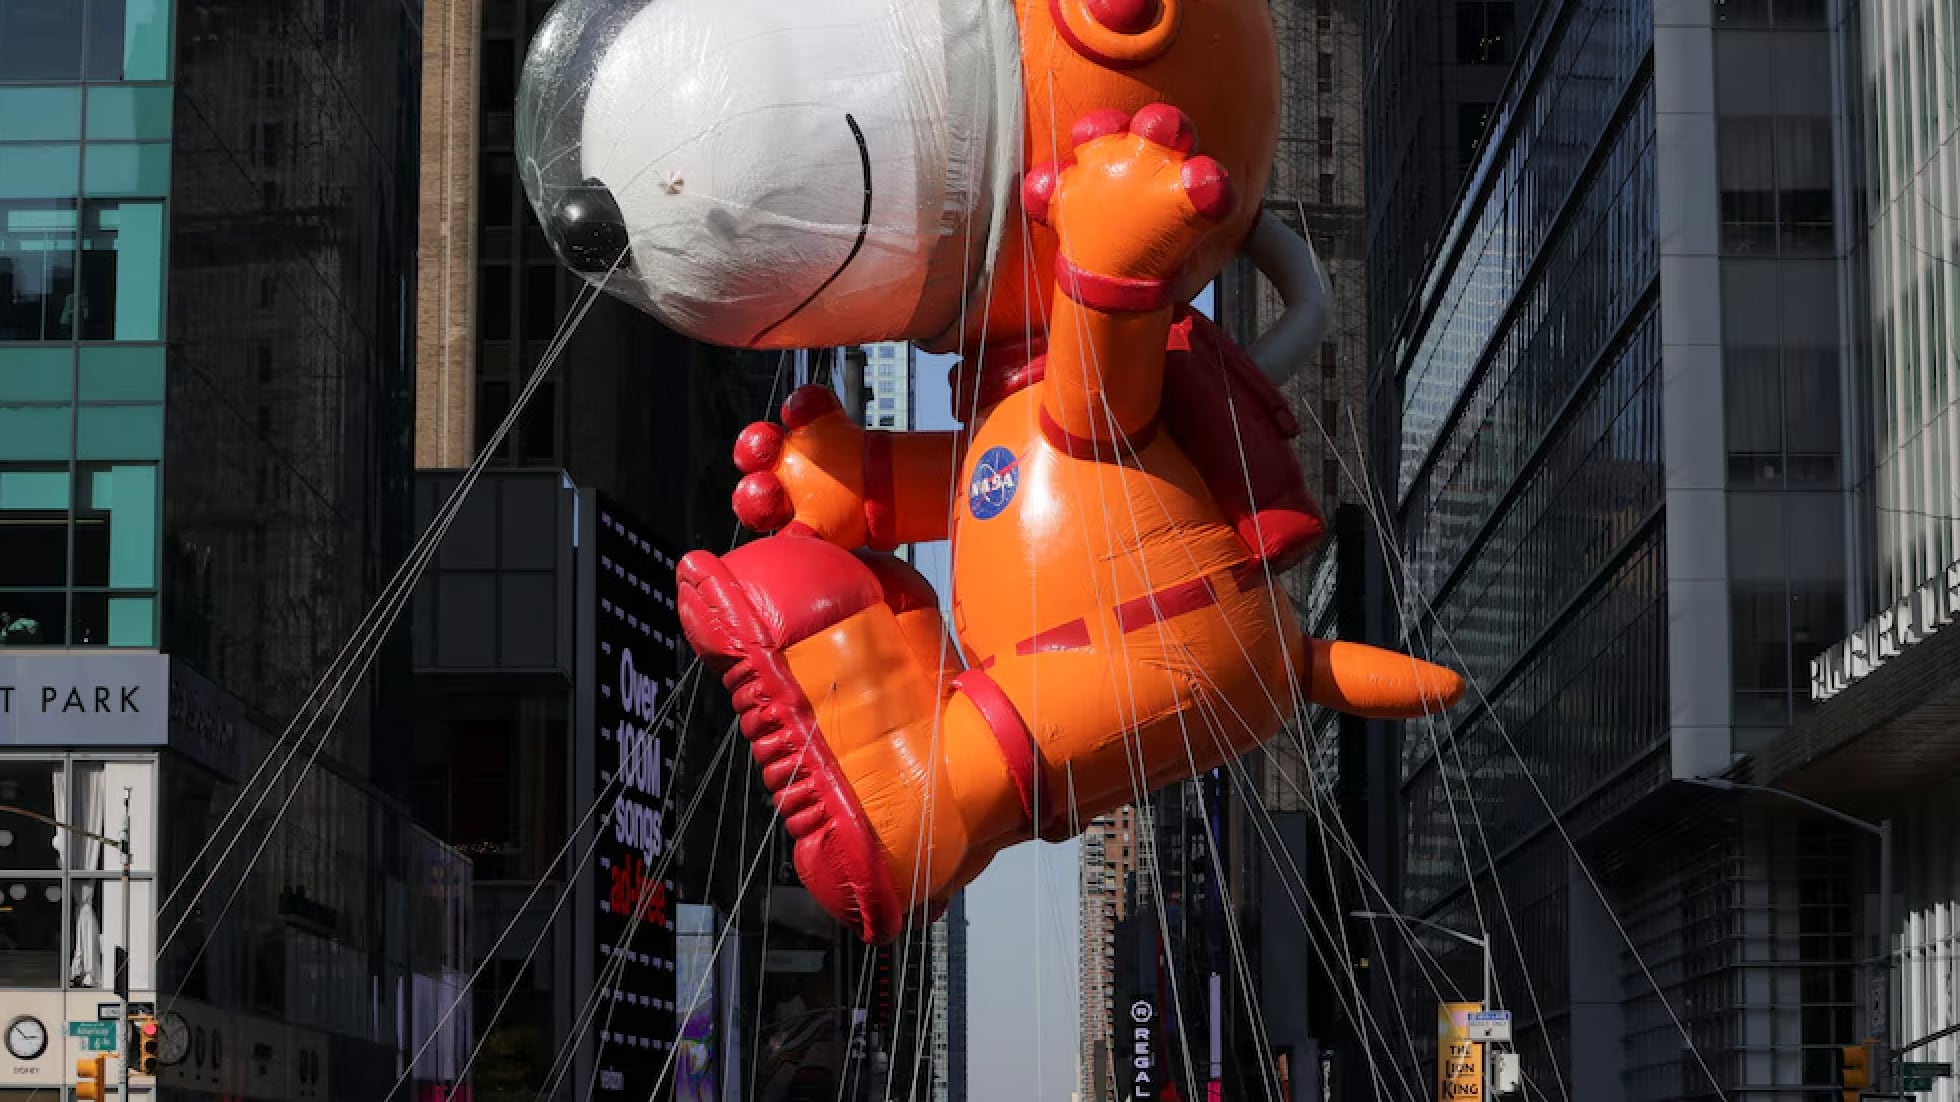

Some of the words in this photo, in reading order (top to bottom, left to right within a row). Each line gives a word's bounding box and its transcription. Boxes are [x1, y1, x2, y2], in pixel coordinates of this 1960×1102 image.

[972, 471, 1015, 498] NASA
[0, 686, 16, 712] T
[41, 685, 140, 713] PARK
[620, 647, 659, 722] Over
[616, 720, 660, 799] 100M
[615, 794, 663, 867] songs
[610, 854, 665, 928] ad-free
[1134, 1027, 1151, 1097] REGAL
[1445, 1060, 1475, 1079] LION
[1450, 1046, 1471, 1055] THE
[1442, 1080, 1479, 1099] KING
